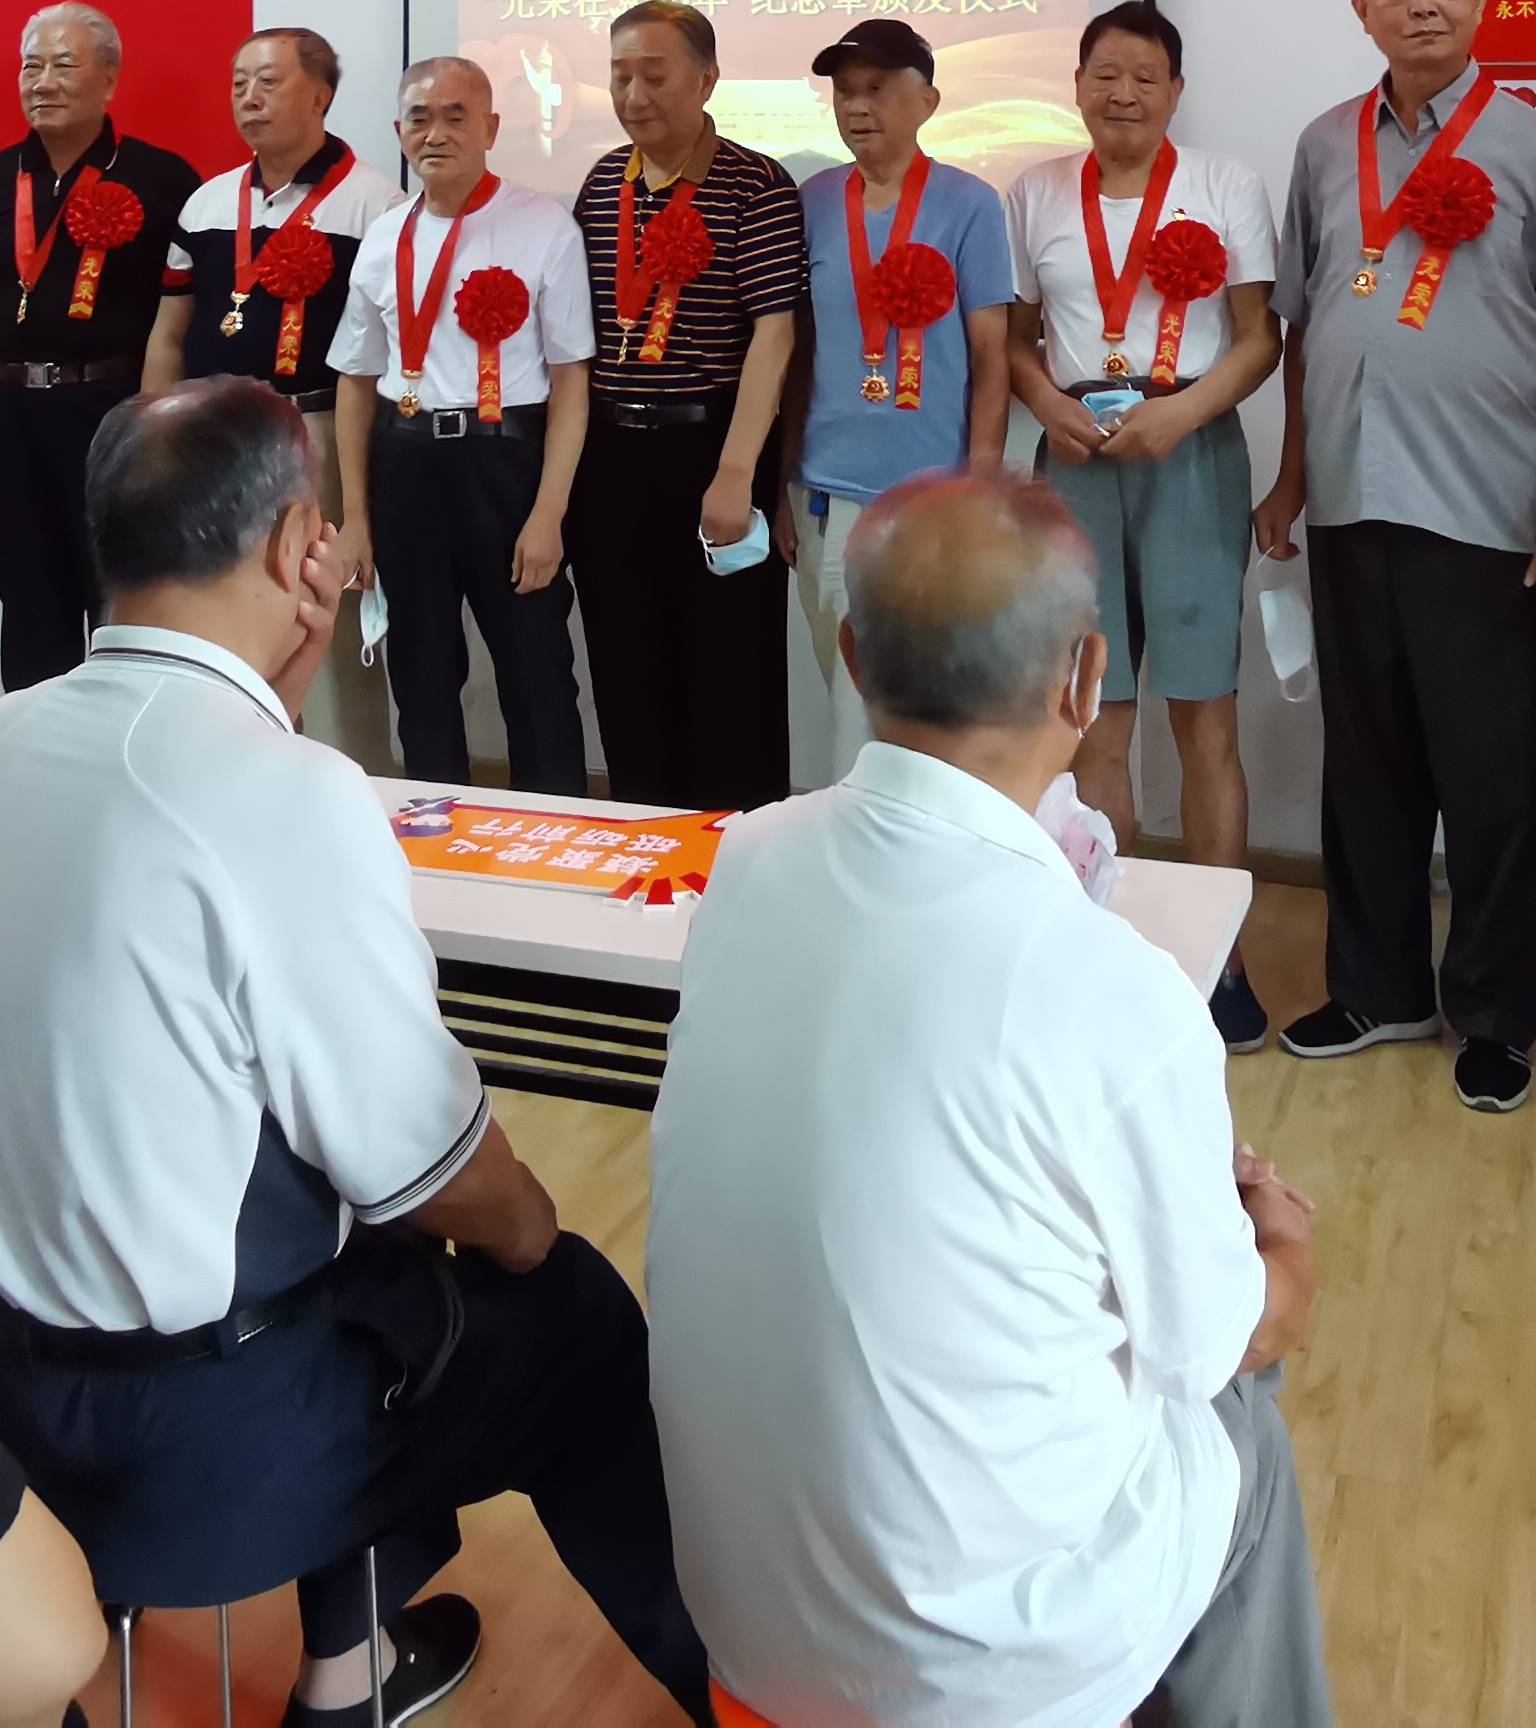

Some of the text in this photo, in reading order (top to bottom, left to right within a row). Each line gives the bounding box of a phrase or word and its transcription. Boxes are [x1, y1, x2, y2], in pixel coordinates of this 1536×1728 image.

[1159, 313, 1182, 365] 光荣
[468, 815, 684, 855] 砥砺前行
[447, 836, 660, 877] 凝聚党心
